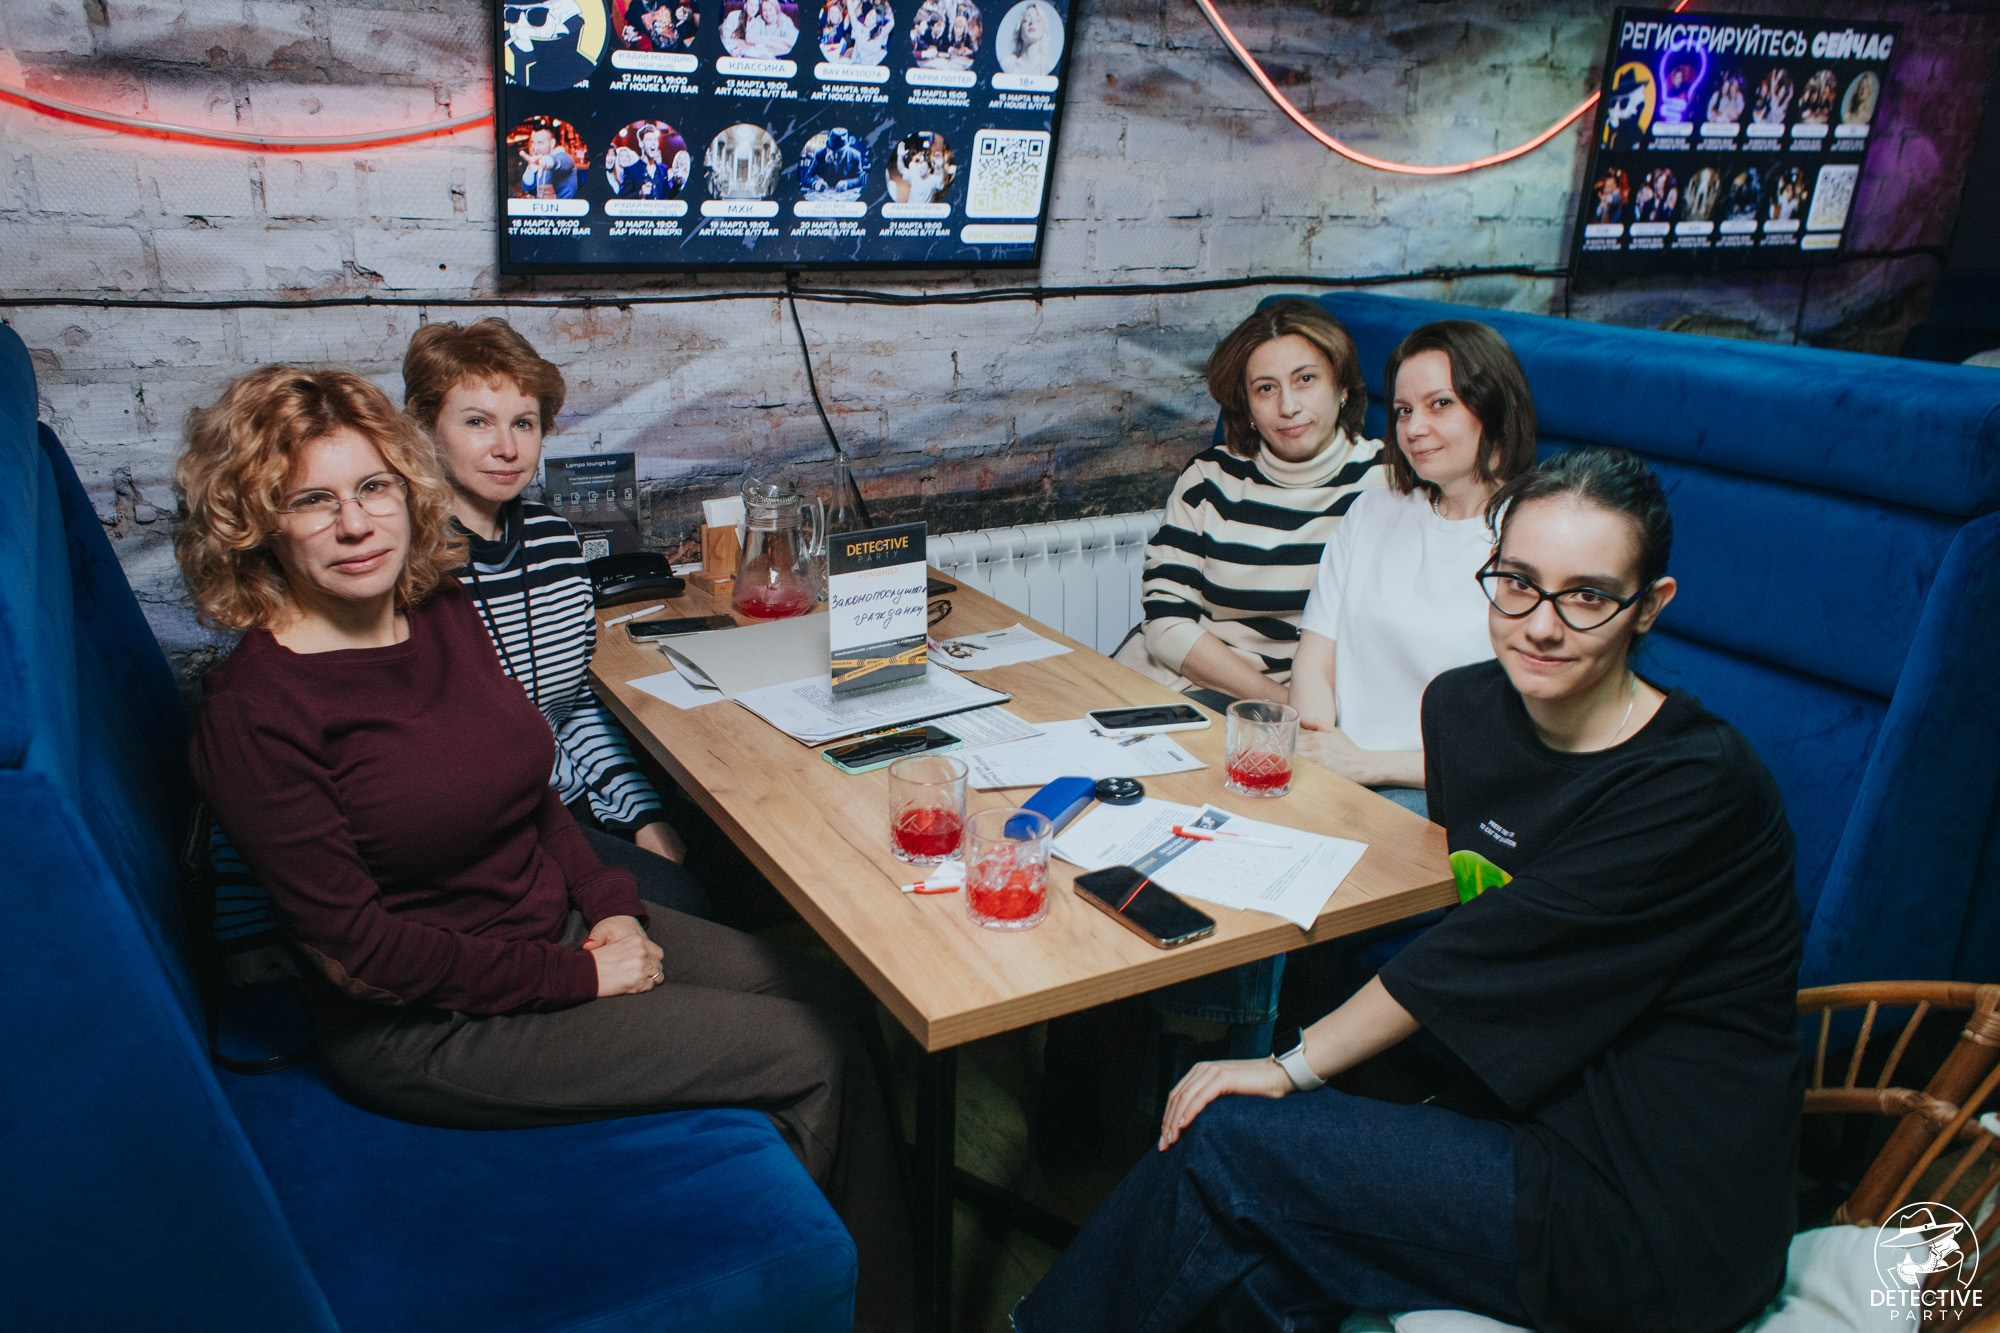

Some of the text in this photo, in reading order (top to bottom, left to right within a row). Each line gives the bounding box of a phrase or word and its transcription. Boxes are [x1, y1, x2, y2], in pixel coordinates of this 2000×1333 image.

[1620, 20, 1895, 61] РЕГИСТРИРУЙТЕСЬ СЕЙЧАС
[728, 61, 786, 72] КЛАССИКА
[621, 73, 632, 82] 12
[633, 74, 664, 84] МАРТА
[912, 72, 972, 83] ГАРРИ ПОТТЕР
[736, 80, 766, 89] МАРТА
[1019, 78, 1034, 87] 18+
[609, 81, 629, 90] ART
[630, 82, 660, 92] HOUSE
[680, 85, 699, 94] BAR
[831, 85, 859, 94] МАРТА
[714, 86, 733, 95] ART
[733, 88, 762, 97] HOUSE
[780, 90, 798, 99] BAR
[922, 89, 948, 98] МАРТА
[810, 91, 828, 100] ART
[828, 92, 855, 102] HOUSE
[872, 95, 889, 104] BAR
[1007, 93, 1031, 102] МАРТА
[988, 99, 1004, 108] ART
[1003, 100, 1028, 109] HOUSE
[532, 203, 560, 213] FUN
[727, 205, 754, 214] МХК
[523, 219, 555, 228] МАРТА
[625, 220, 656, 228] МАРТА
[719, 220, 748, 229] МАРТА
[811, 221, 838, 229] МАРТА
[897, 221, 923, 229] МАРТА
[520, 227, 551, 236] HOUSE
[572, 227, 591, 236] BAR
[609, 228, 628, 236] БАР
[628, 228, 652, 236] РУКИ
[698, 228, 715, 237] ART
[716, 228, 744, 237] HOUSE
[762, 228, 780, 237] BAR
[790, 229, 807, 237] ART
[807, 229, 833, 237] HOUSE
[850, 229, 867, 237] BAR
[878, 229, 894, 237] ART
[895, 229, 919, 237] HOUSE
[846, 535, 909, 557] DETECTIVE
[857, 551, 899, 563] PARTY
[857, 567, 900, 581] команда
